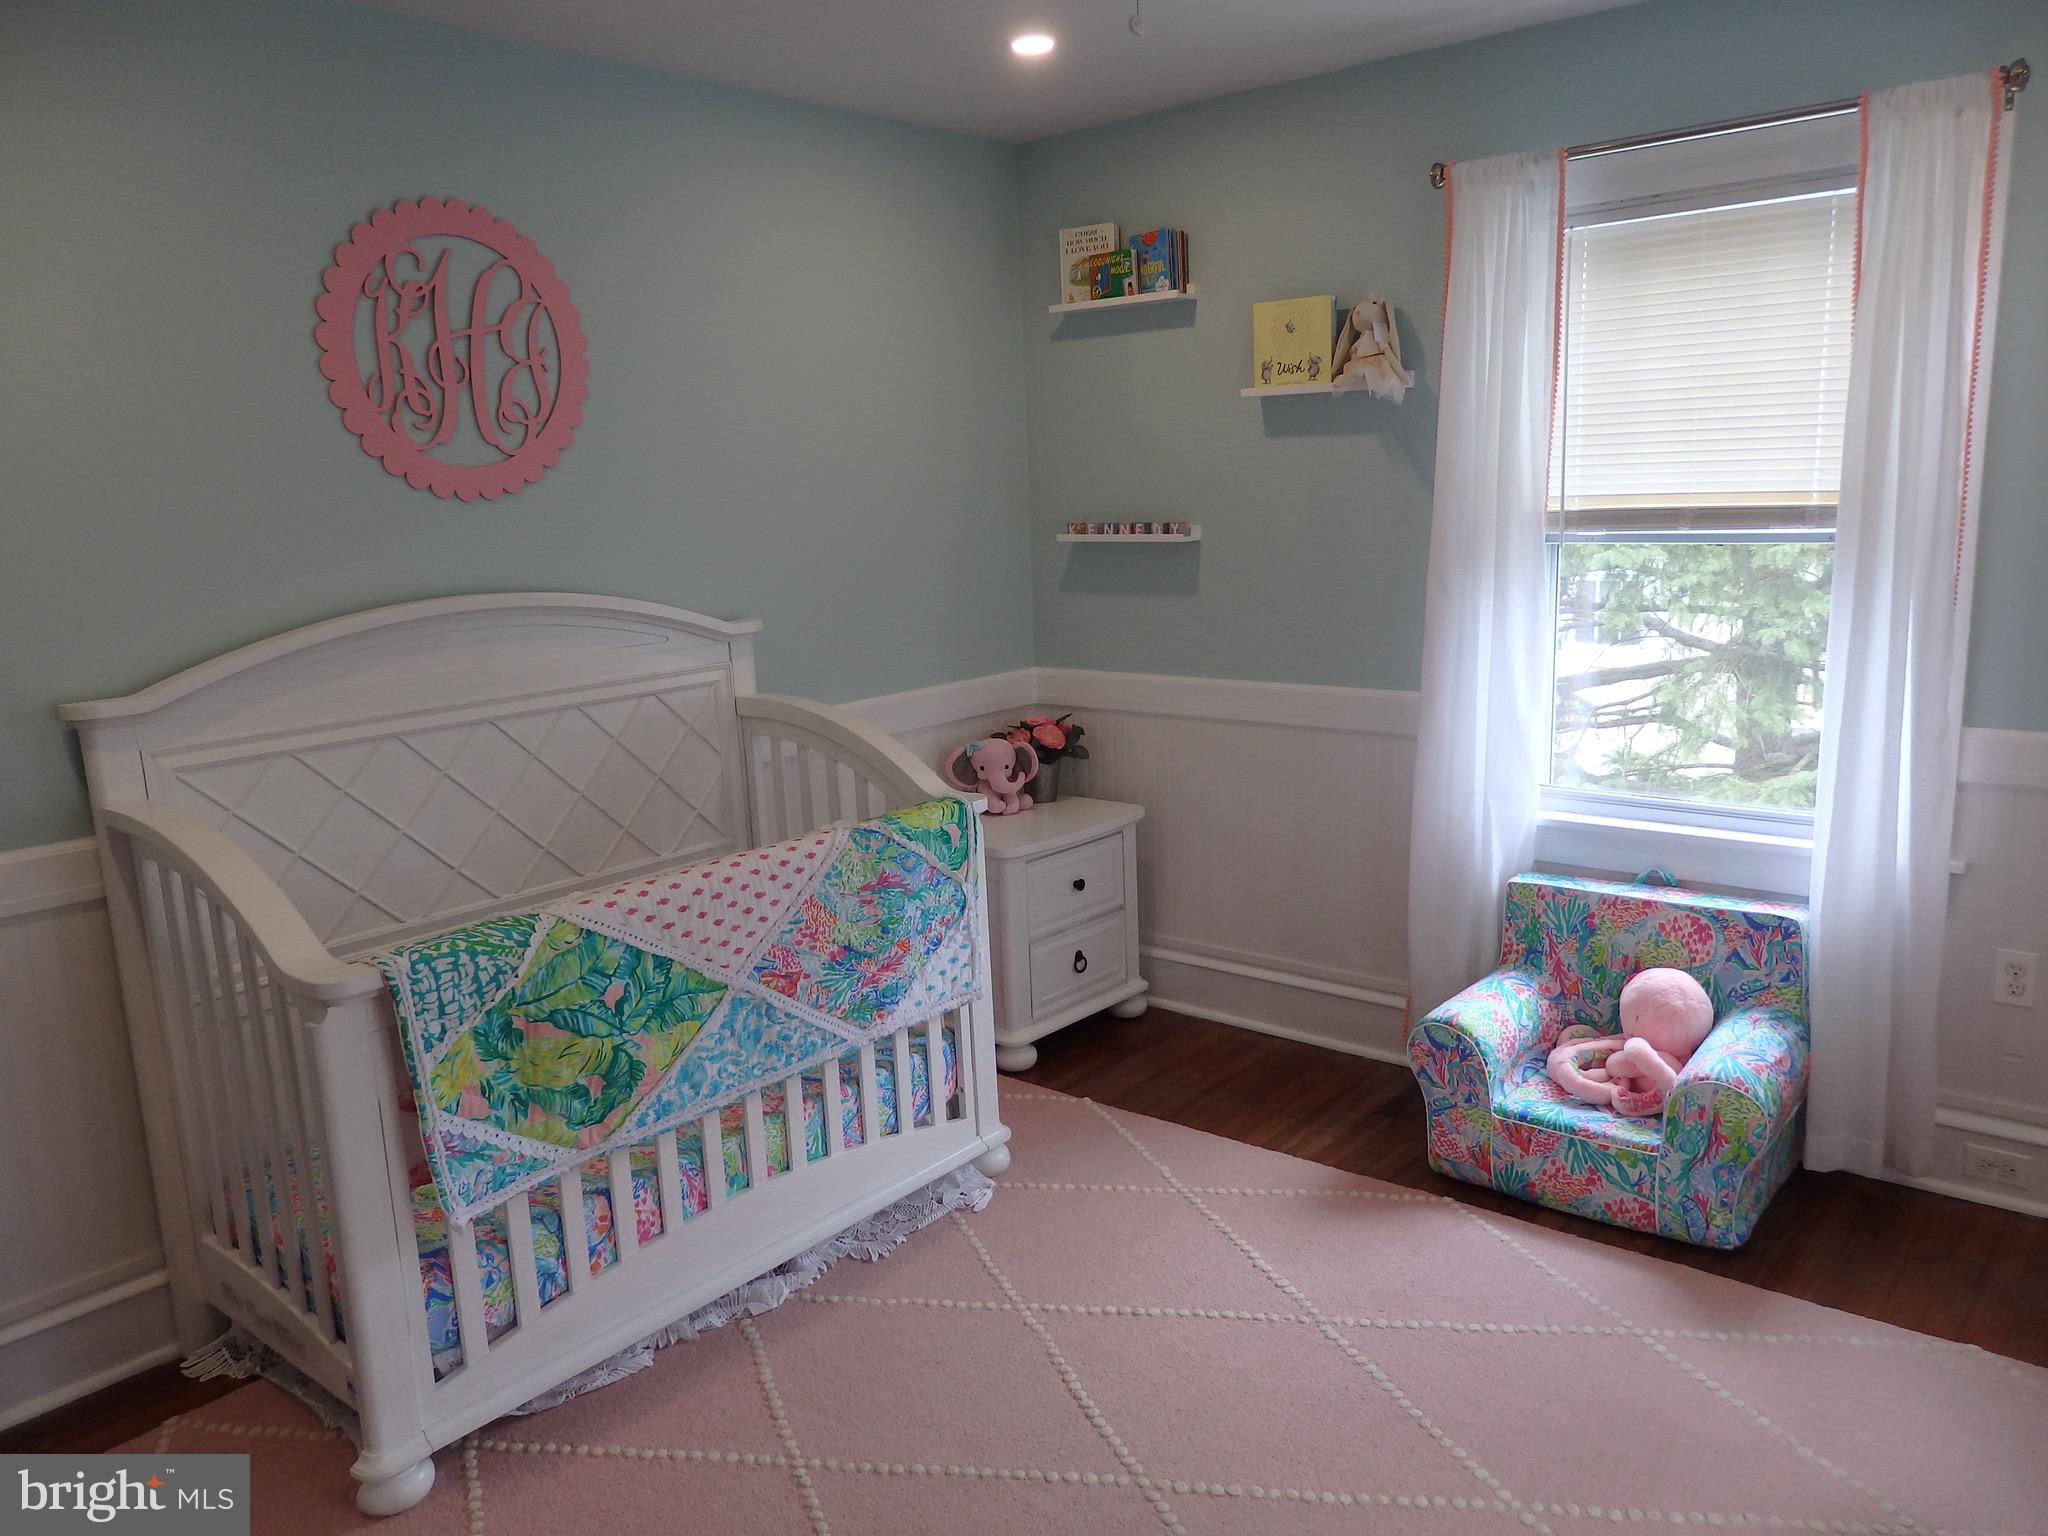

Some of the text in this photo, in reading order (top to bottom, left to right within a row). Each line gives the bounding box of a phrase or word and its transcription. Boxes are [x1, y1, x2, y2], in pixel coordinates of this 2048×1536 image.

[1085, 235, 1107, 243] MUCH
[1071, 246, 1092, 255] LOVE
[1092, 242, 1109, 252] YOU
[1277, 359, 1306, 376] Wish
[1068, 523, 1180, 536] KENNEDY
